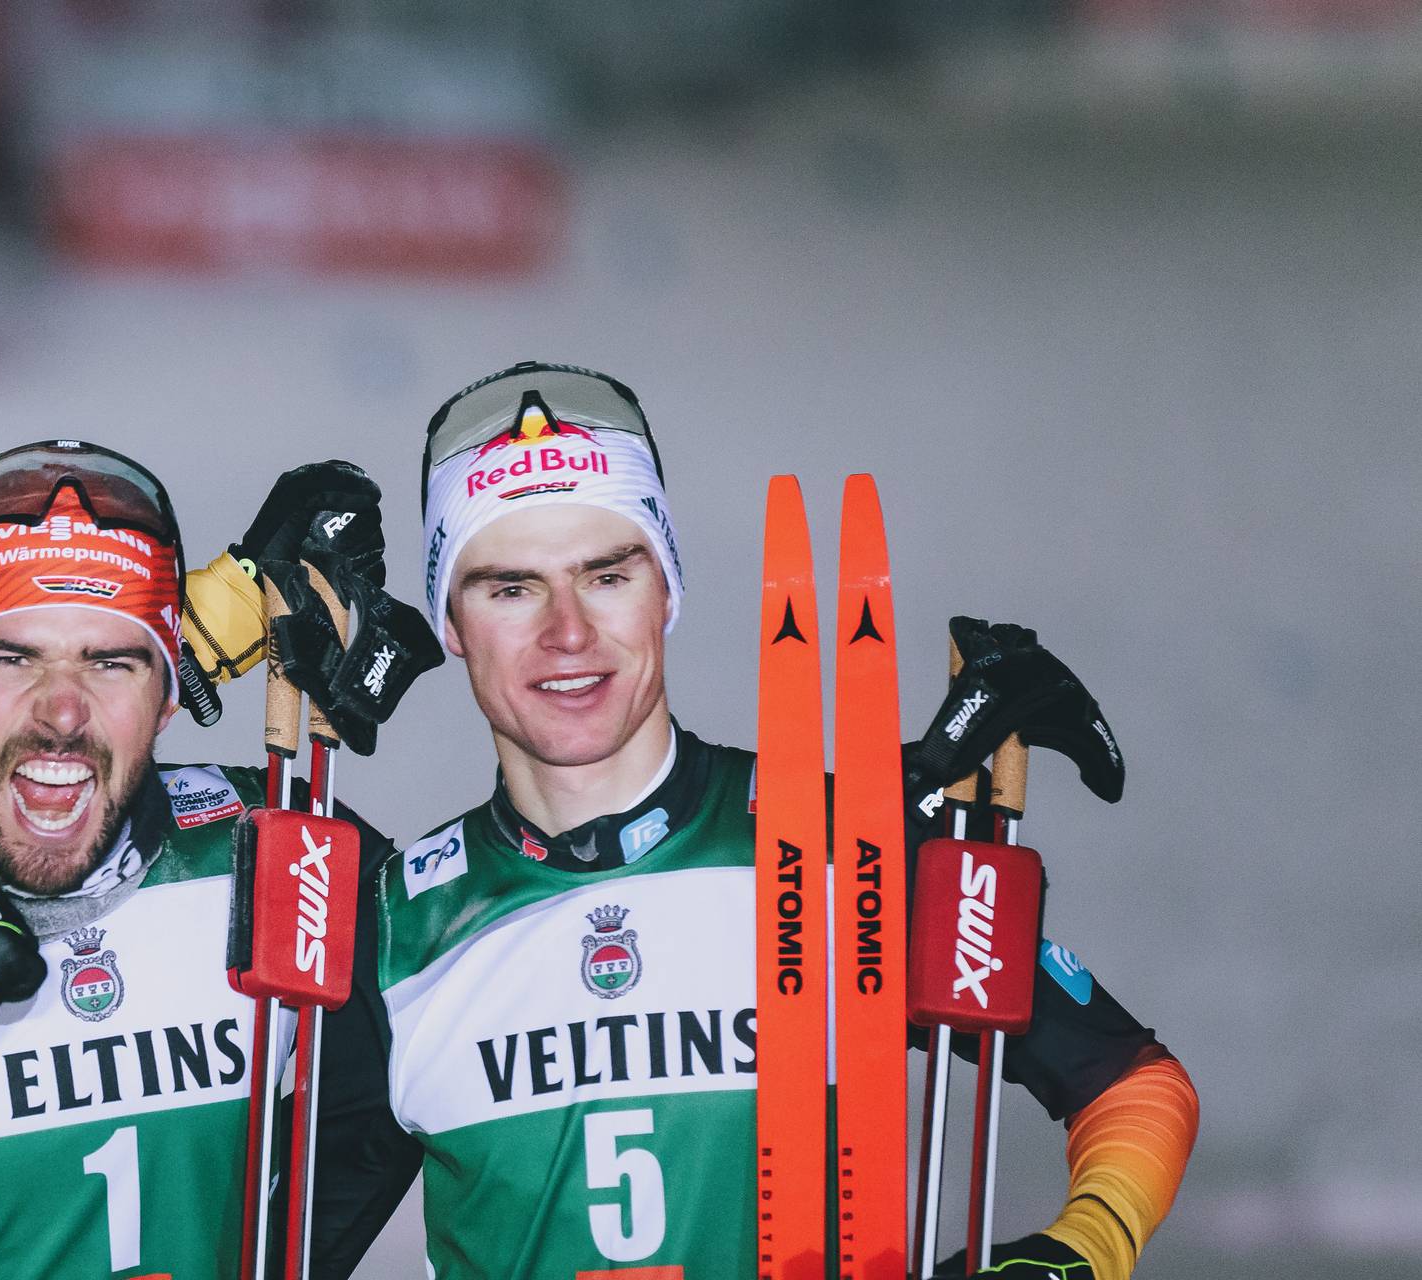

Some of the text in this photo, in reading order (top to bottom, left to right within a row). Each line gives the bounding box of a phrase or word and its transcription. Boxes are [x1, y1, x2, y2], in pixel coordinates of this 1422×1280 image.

[466, 448, 609, 498] Red Bull
[171, 788, 213, 800] NORDIC
[174, 789, 230, 807] COMBINED
[175, 799, 225, 813] WORLD CUP
[182, 805, 239, 823] VIESSMANN
[777, 839, 803, 996] ATOMIC
[856, 838, 883, 996] ATOMIC
[477, 1008, 757, 1103] VELTINS
[83, 1126, 141, 1272] 1
[584, 1108, 666, 1262] 5
